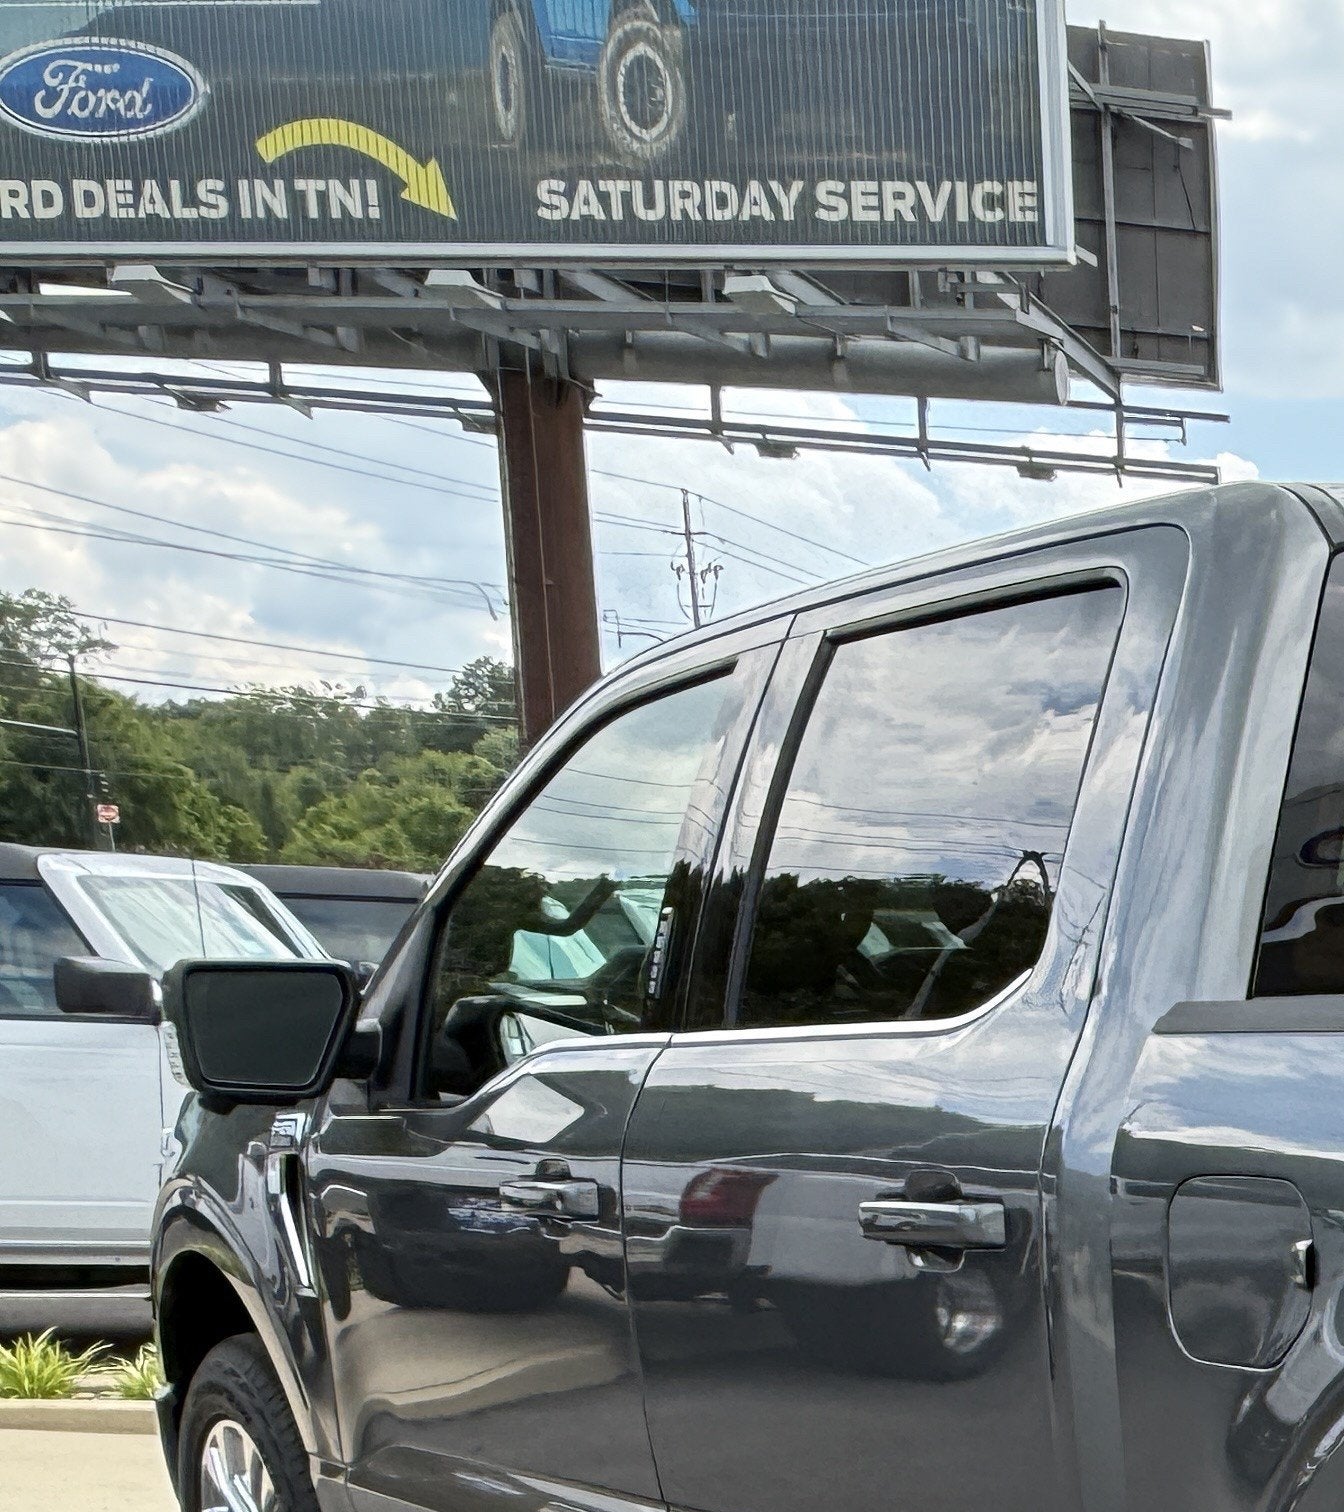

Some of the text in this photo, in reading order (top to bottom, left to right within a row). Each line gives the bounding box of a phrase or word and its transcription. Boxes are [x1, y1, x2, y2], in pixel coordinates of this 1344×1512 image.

[34, 59, 154, 119] Ford
[72, 179, 229, 219] DEALS
[238, 179, 289, 219] IN
[294, 179, 381, 220] TN!
[536, 179, 1039, 222] SATURDAY SERVICE
